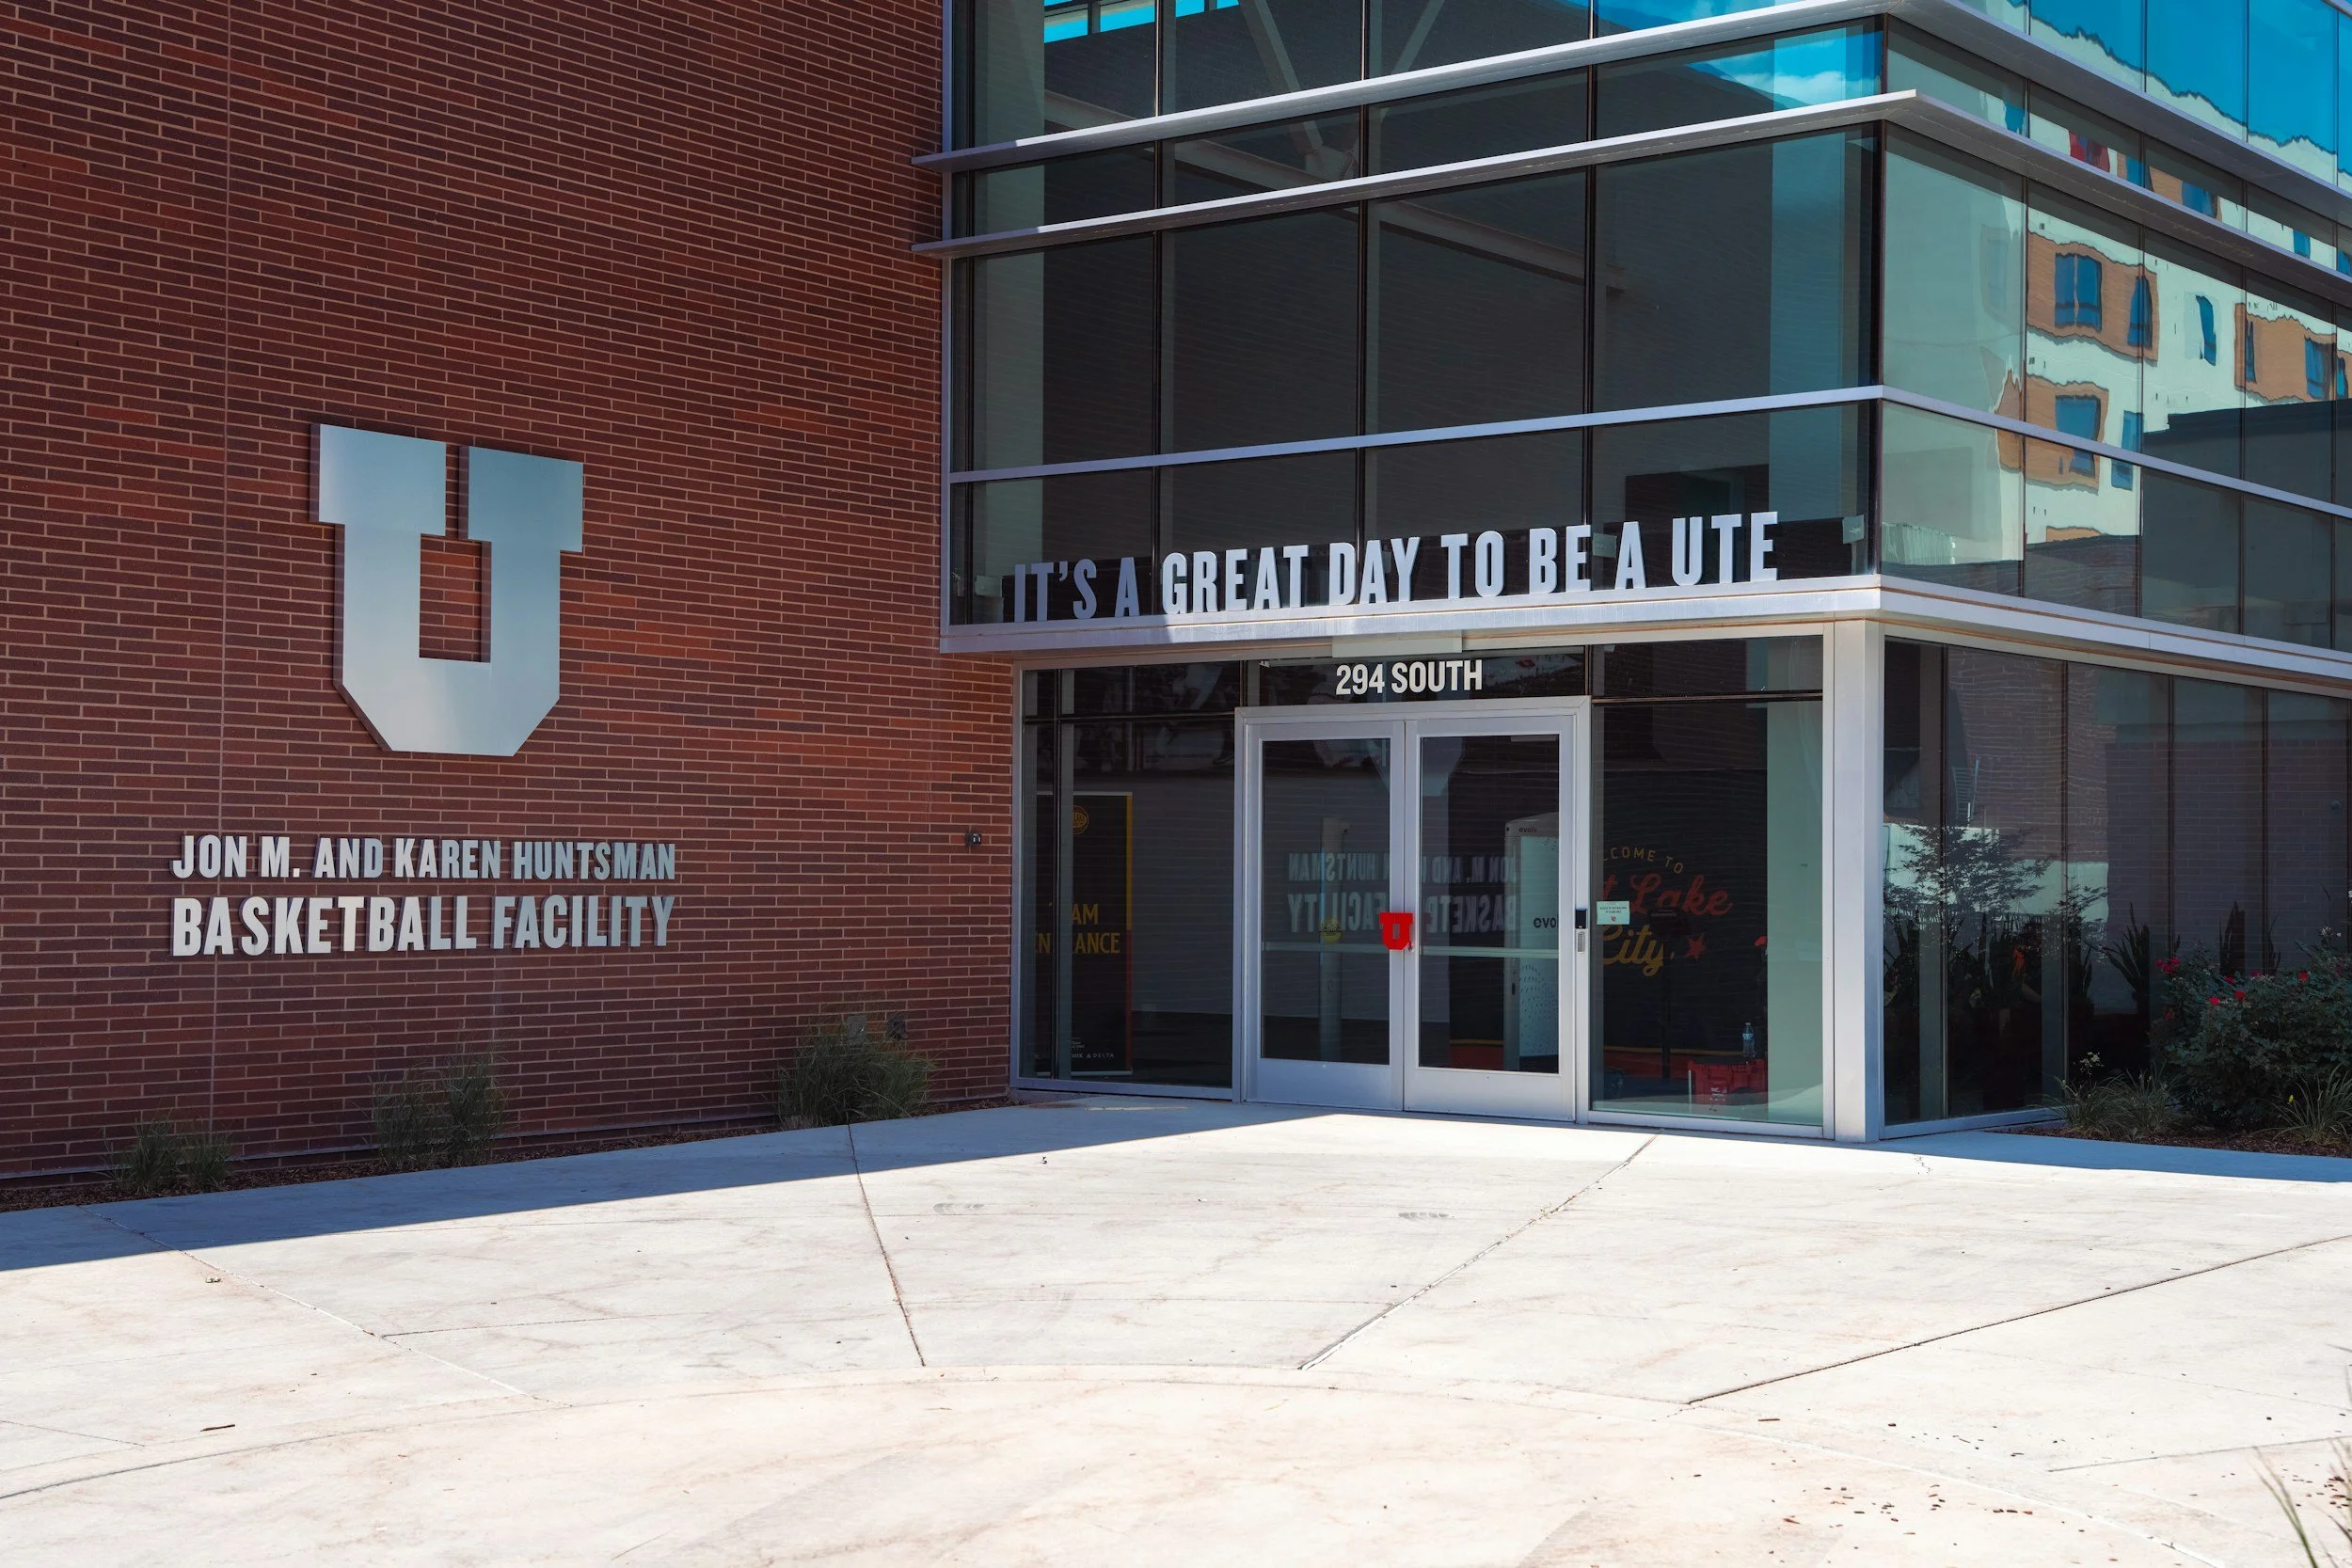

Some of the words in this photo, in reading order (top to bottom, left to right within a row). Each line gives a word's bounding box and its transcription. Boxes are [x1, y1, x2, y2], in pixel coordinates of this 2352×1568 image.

[310, 423, 584, 757] U
[1013, 558, 1098, 623] IT'S
[1114, 556, 1140, 618] A
[1162, 544, 1310, 615] GREAT
[1328, 536, 1421, 607] DAY
[1440, 530, 1505, 599] TO
[1529, 524, 1592, 594] BE
[1614, 521, 1646, 590] A
[1672, 511, 1778, 587] UTE
[1336, 663, 1385, 696] 294
[1391, 658, 1483, 694] SOUTH
[169, 833, 247, 879] JON
[260, 836, 300, 879] M.
[313, 837, 384, 879] AND
[393, 837, 501, 879] KAREN
[512, 841, 676, 880] HUNTSMAN
[1603, 846, 1656, 863] COME
[1664, 855, 1685, 875] TO
[171, 895, 478, 958] BASKETBALL
[492, 894, 676, 950] FACILITY
[1036, 931, 1121, 955] NANCE
